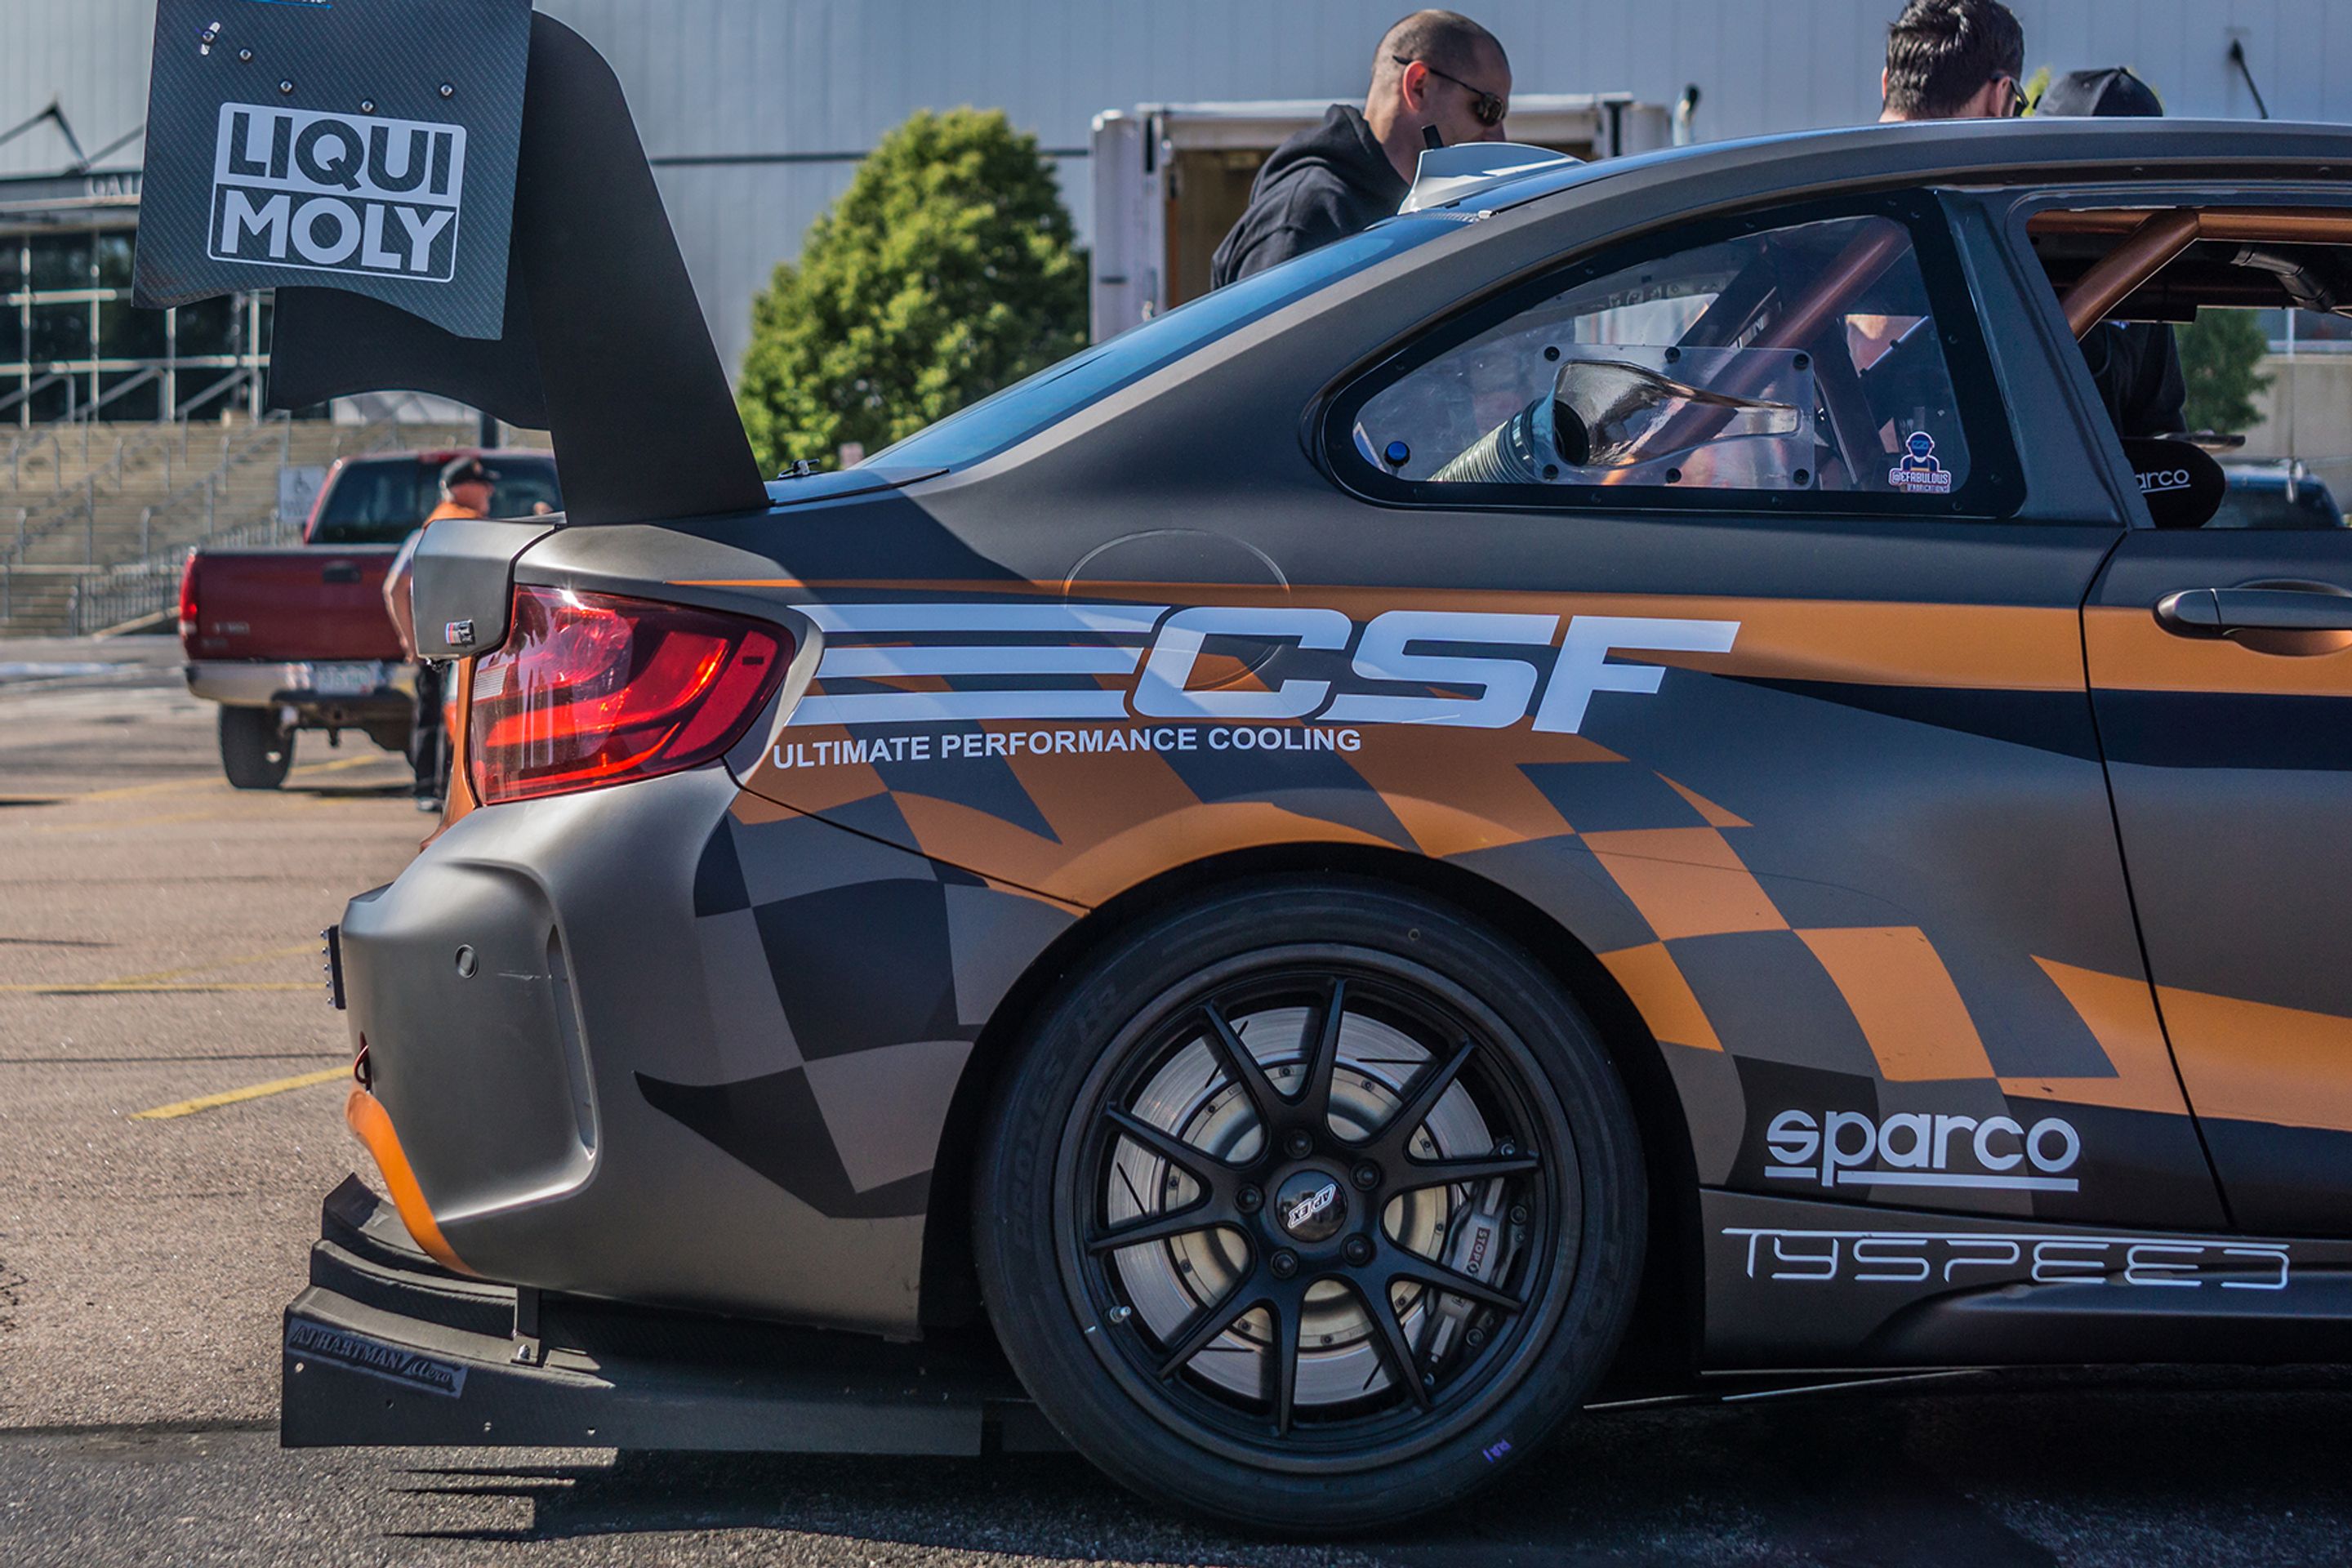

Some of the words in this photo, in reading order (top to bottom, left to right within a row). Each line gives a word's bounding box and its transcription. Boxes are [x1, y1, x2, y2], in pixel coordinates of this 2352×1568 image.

[228, 111, 453, 195] LIQUI
[220, 189, 456, 272] MOLY
[1134, 606, 1742, 734] CSF
[773, 736, 930, 769] ULTIMATE
[942, 727, 1198, 759] PERFORMANCE
[1209, 725, 1361, 752] COOLING
[1765, 1109, 2081, 1192] sparco
[1288, 1184, 1336, 1229] APEX
[1722, 1227, 2290, 1290] TYSPEED
